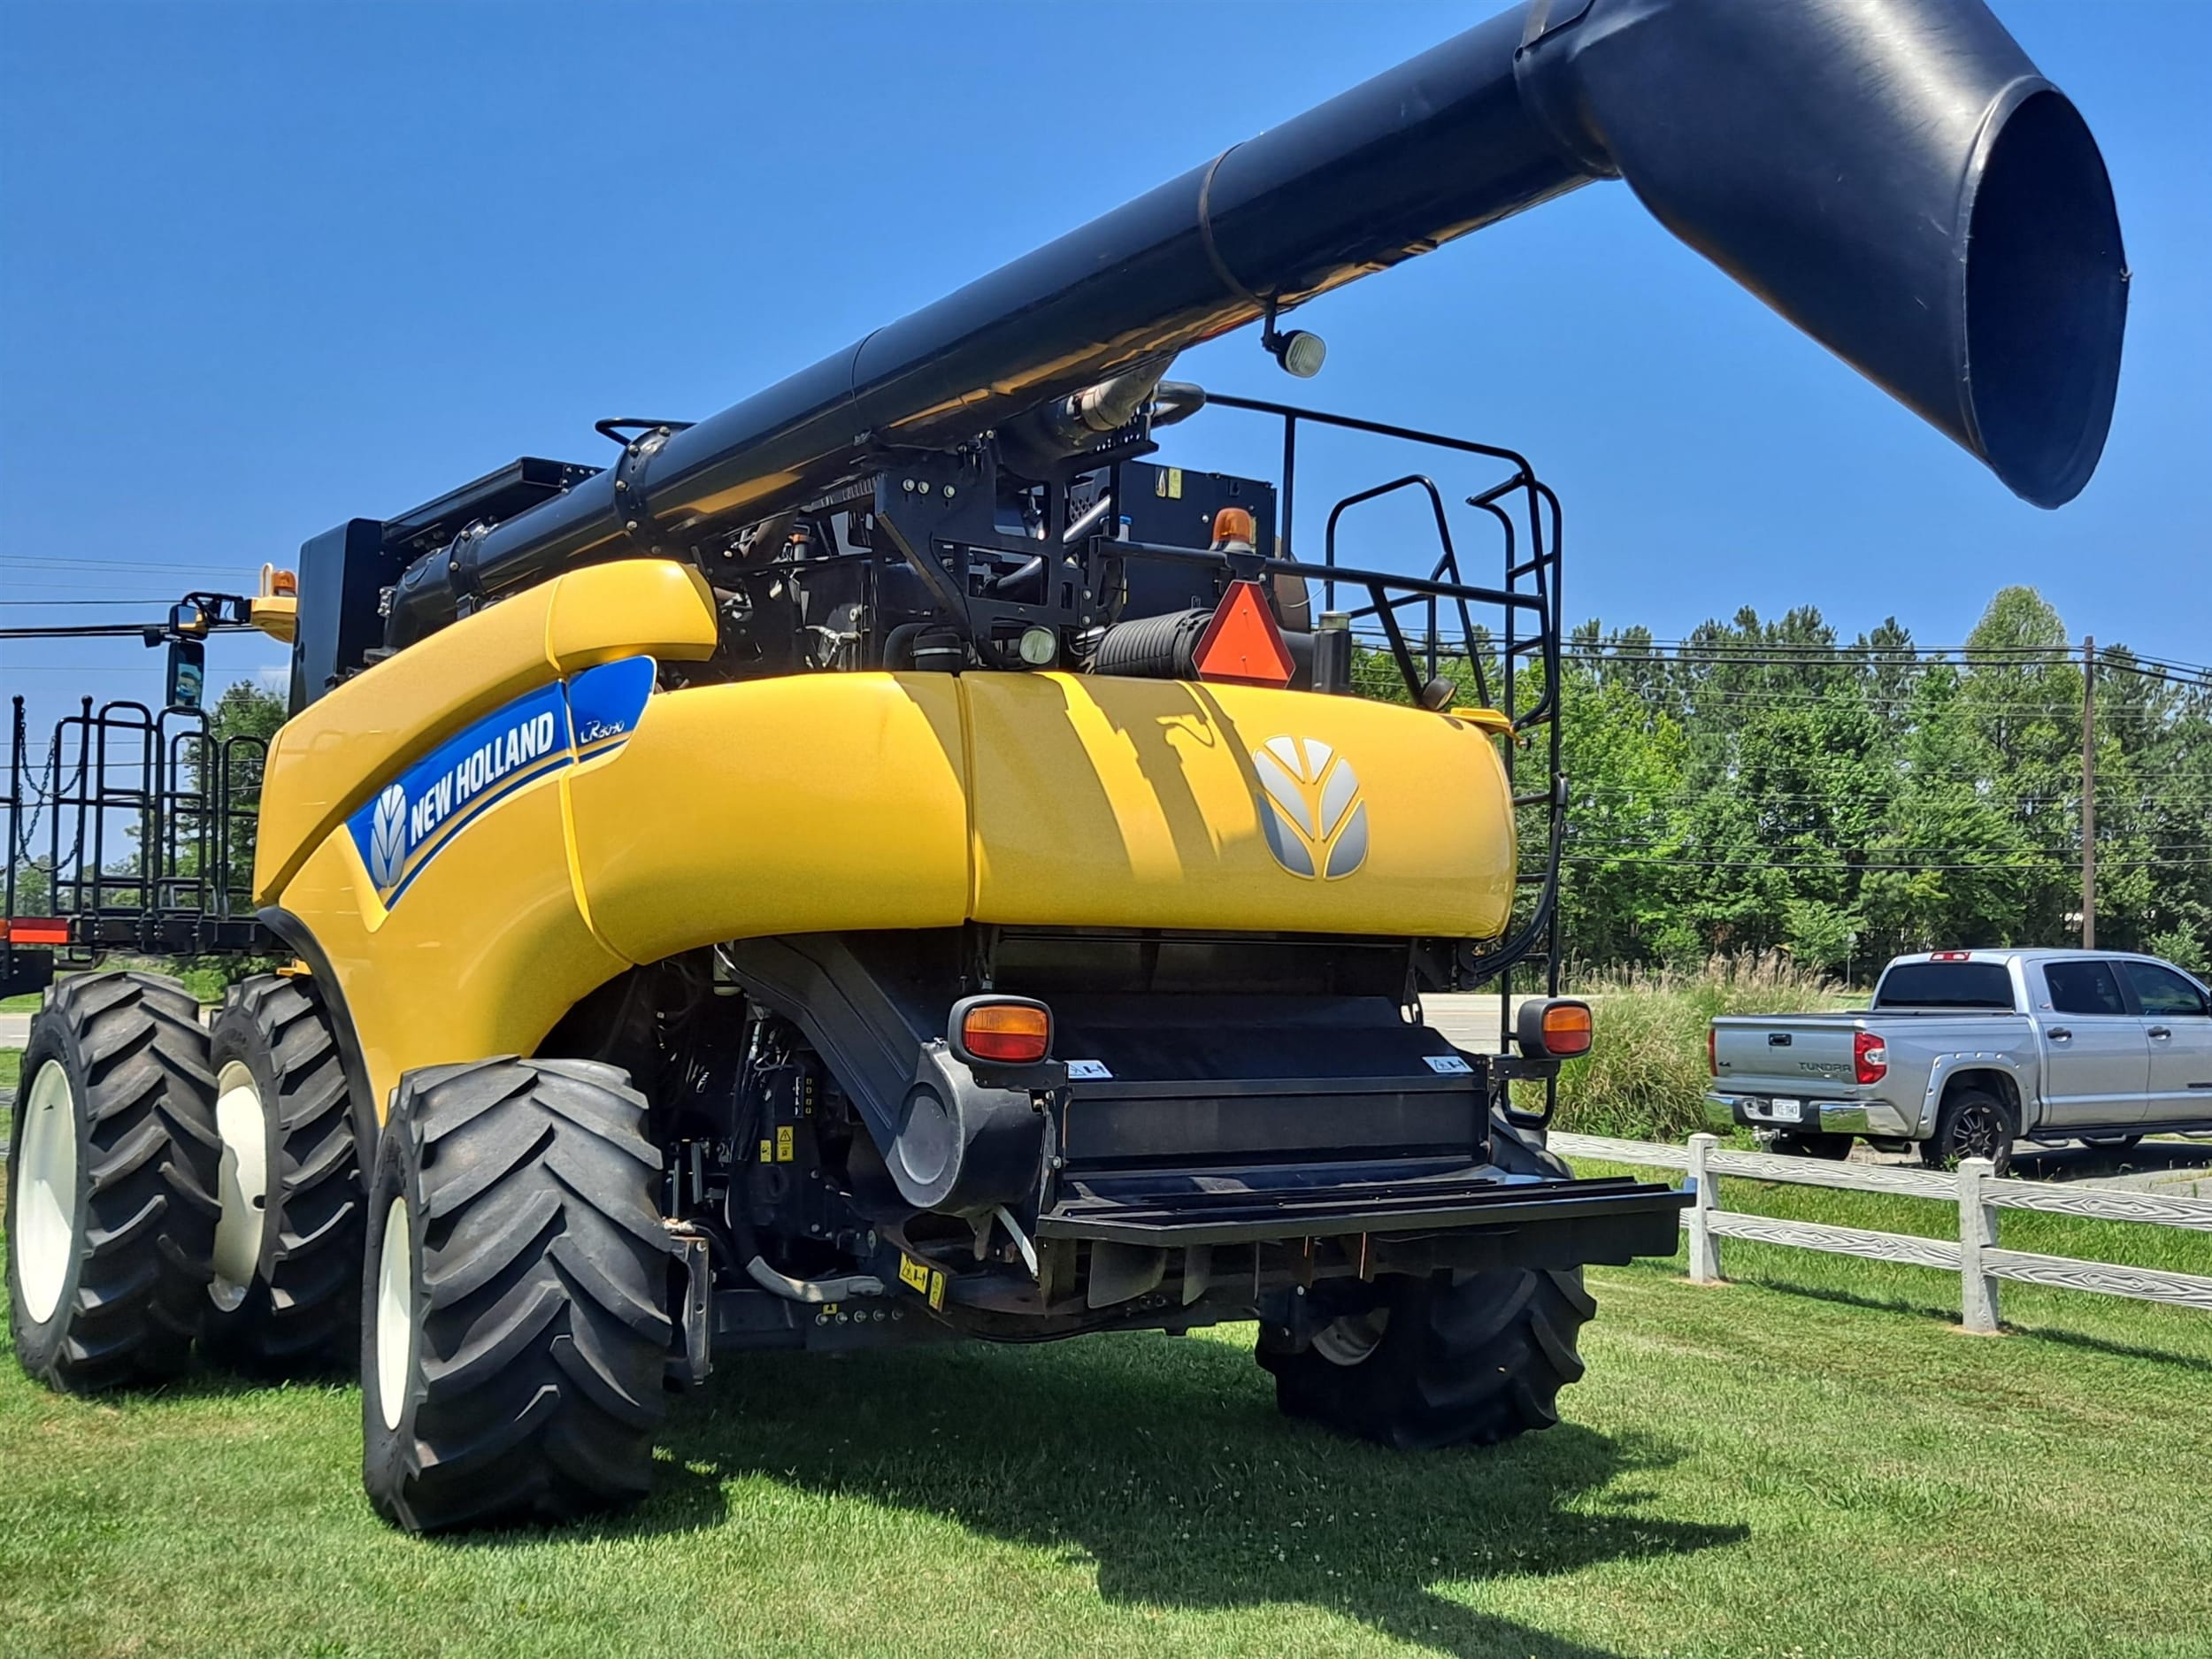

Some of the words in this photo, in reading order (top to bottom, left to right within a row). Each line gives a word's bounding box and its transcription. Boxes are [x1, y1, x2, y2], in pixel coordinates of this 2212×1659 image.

[411, 770, 453, 847] NEW
[456, 711, 554, 805] HOLLAND
[1798, 1062, 1852, 1073] TUNDRA
